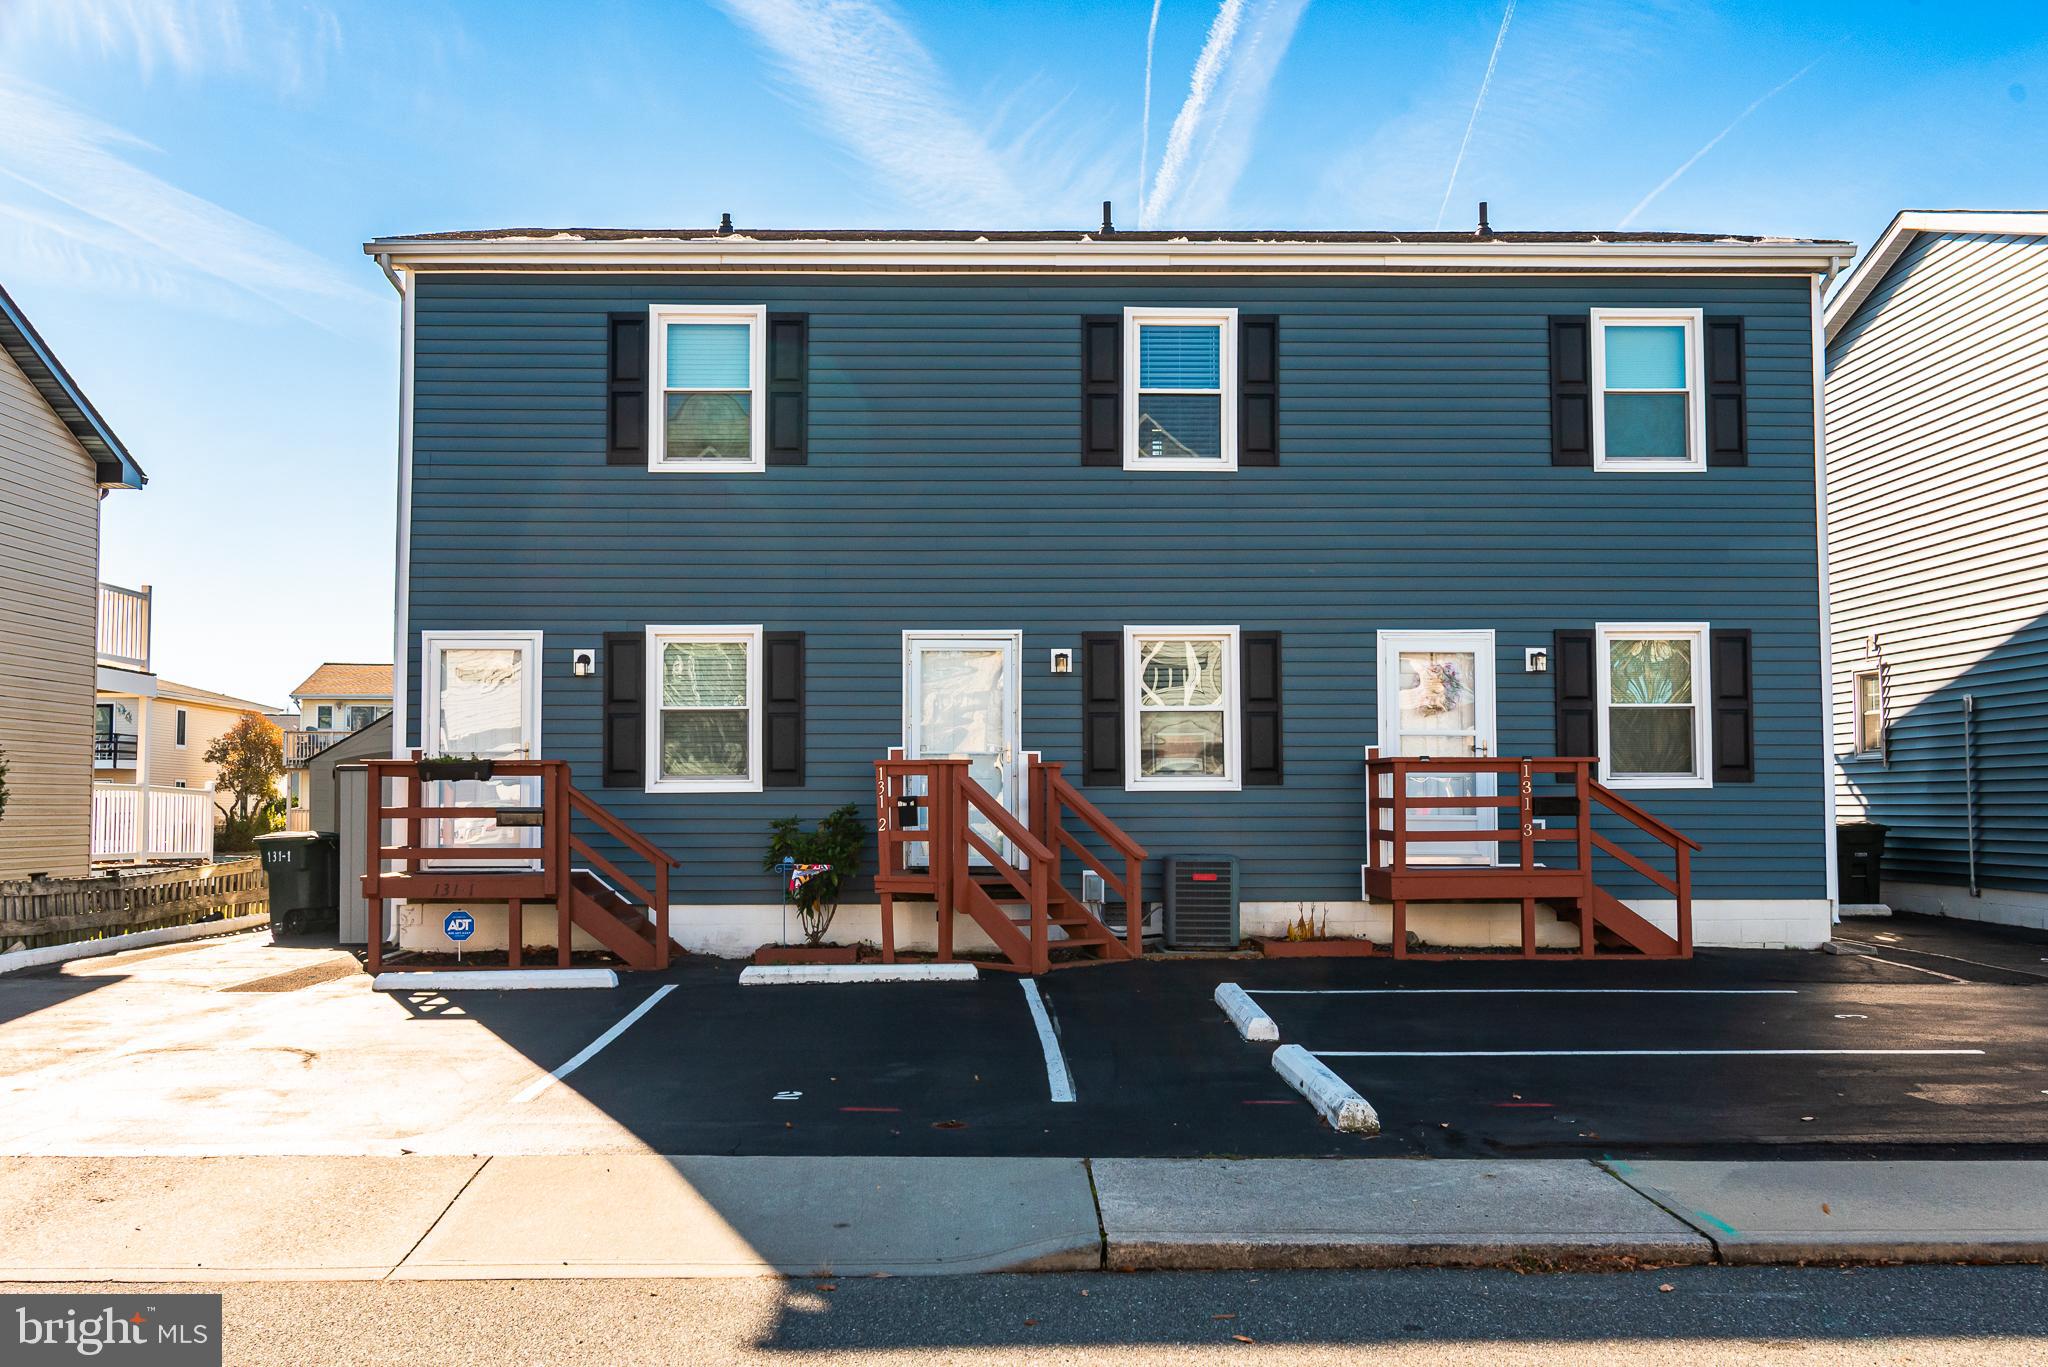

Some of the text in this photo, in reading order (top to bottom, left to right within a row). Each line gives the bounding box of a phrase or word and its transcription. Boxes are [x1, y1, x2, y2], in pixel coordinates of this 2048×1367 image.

[267, 850, 291, 862] 131-1
[447, 919, 472, 931] ADT
[772, 1091, 803, 1100] 2
